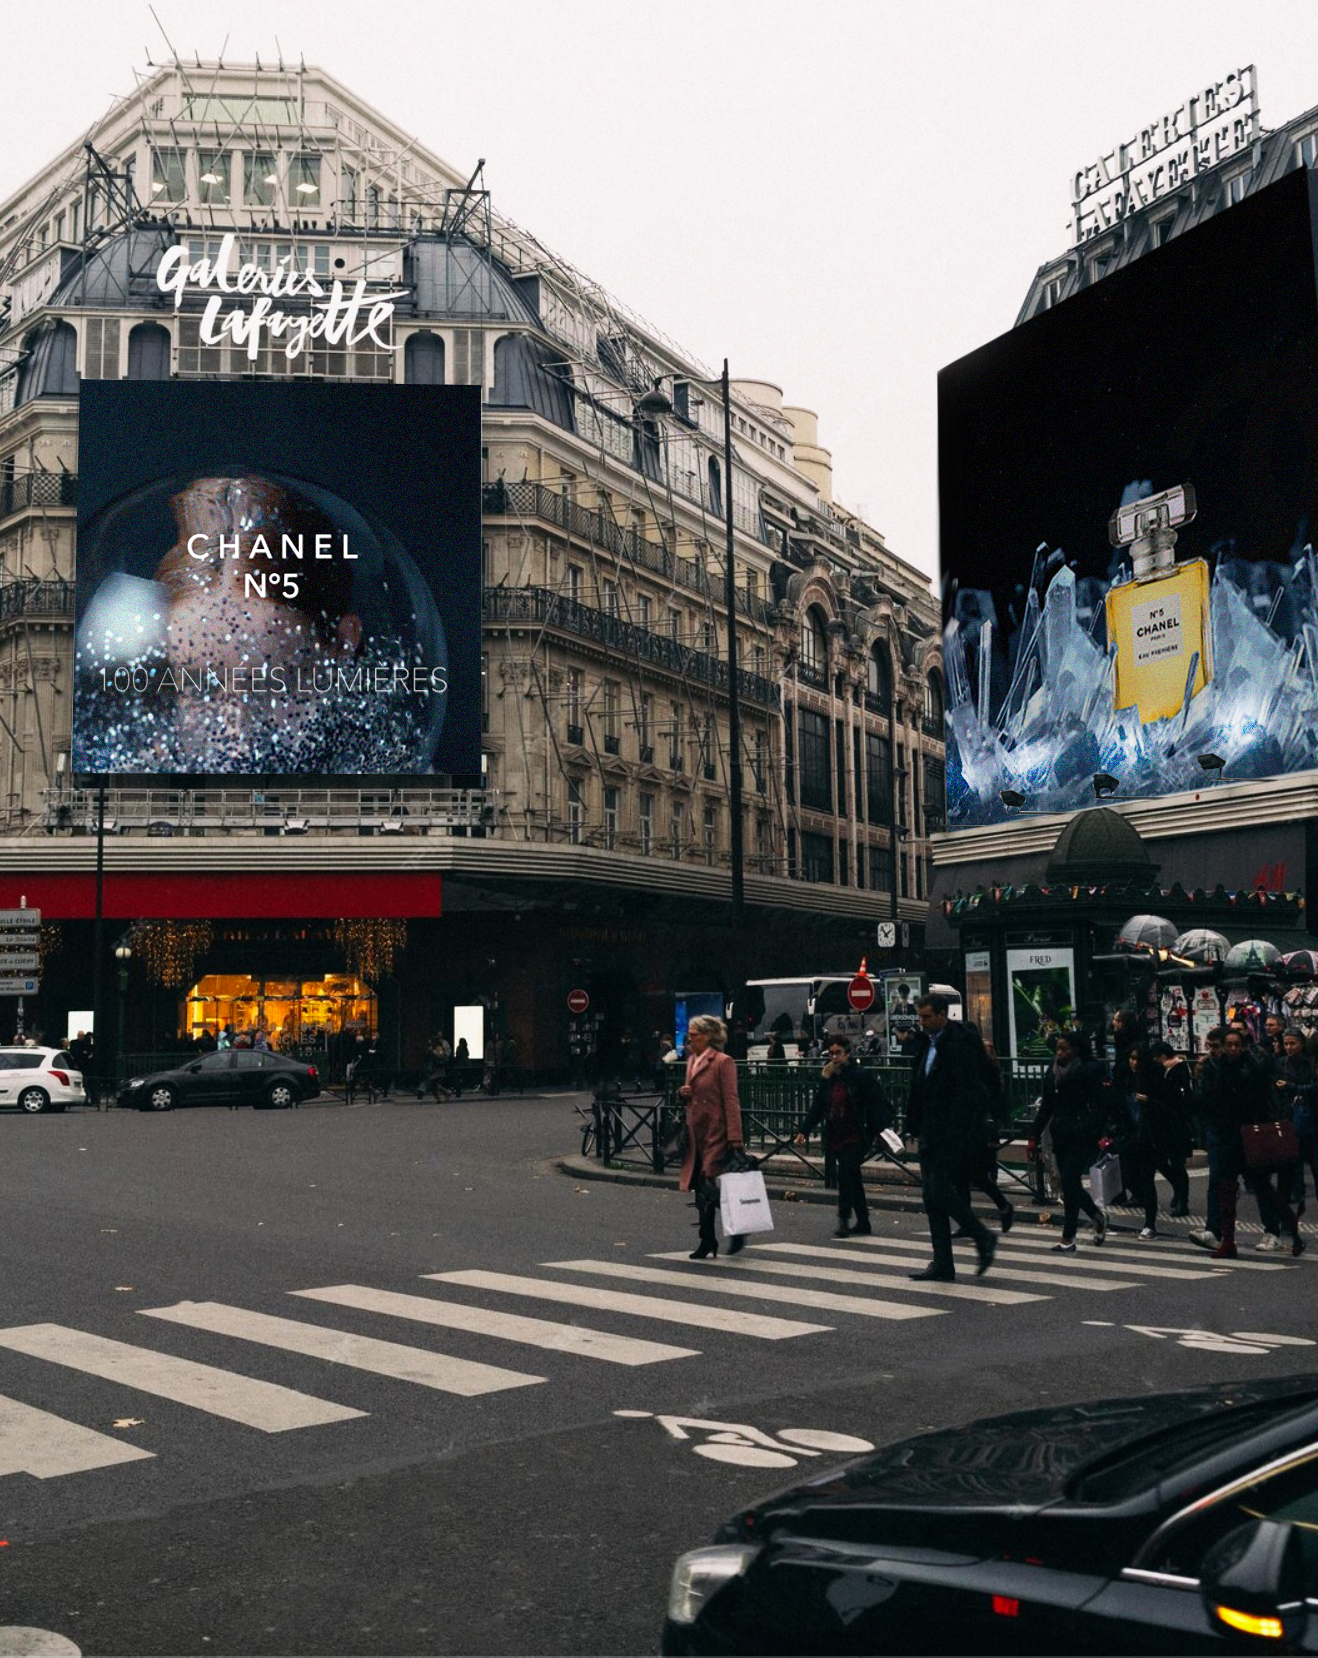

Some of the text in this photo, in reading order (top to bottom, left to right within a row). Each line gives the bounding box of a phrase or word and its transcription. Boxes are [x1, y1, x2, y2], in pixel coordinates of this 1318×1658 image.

[1070, 68, 1245, 201] GALERIES
[1067, 113, 1255, 249] LAFAYETTE
[200, 280, 410, 360] Lafayette
[187, 533, 359, 560] CHANEL
[244, 572, 300, 599] N°5
[1136, 617, 1180, 638] CHANEL
[99, 661, 449, 693] 100 ANNÉES LUMIÈRES
[1029, 955, 1052, 966] FRED
